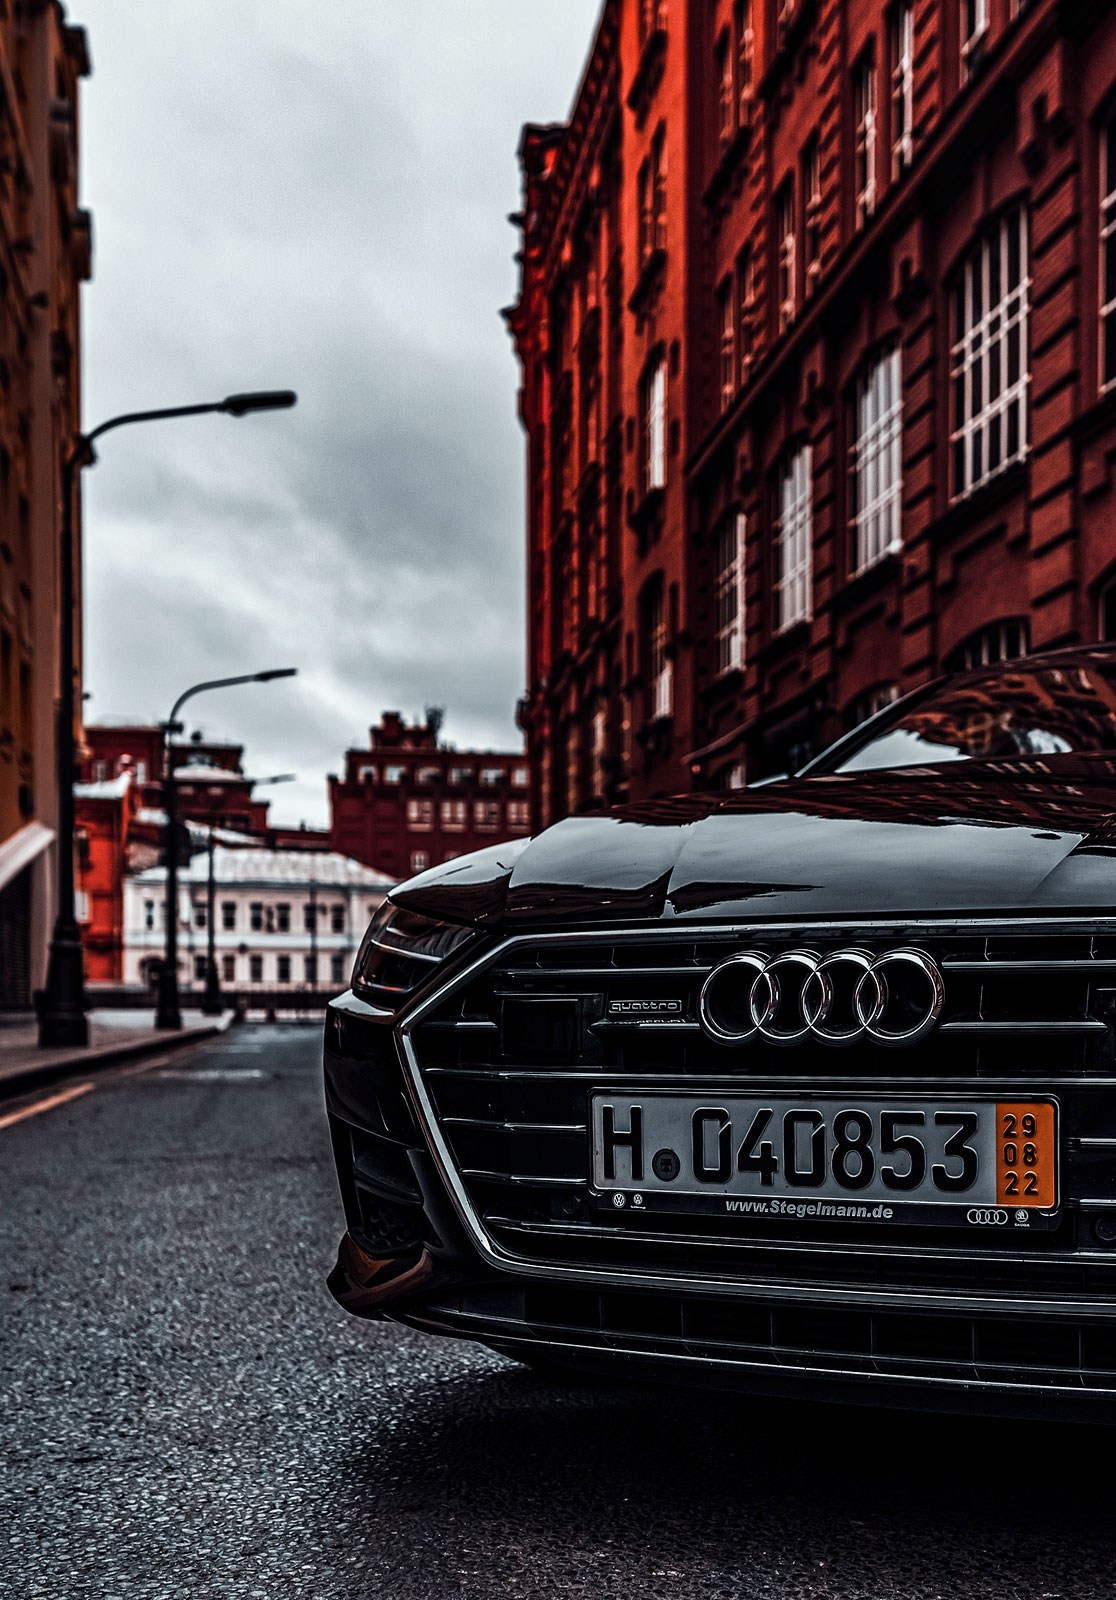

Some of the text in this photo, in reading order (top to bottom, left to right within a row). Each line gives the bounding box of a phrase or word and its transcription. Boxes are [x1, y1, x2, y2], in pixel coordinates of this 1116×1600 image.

[611, 1002, 678, 1012] quattro
[1003, 1113, 1036, 1138] 29
[602, 1104, 979, 1192] H 040853
[1003, 1142, 1037, 1166] 08
[1004, 1171, 1039, 1195] 22
[725, 1199, 894, 1219] www.Stegelmann.de
